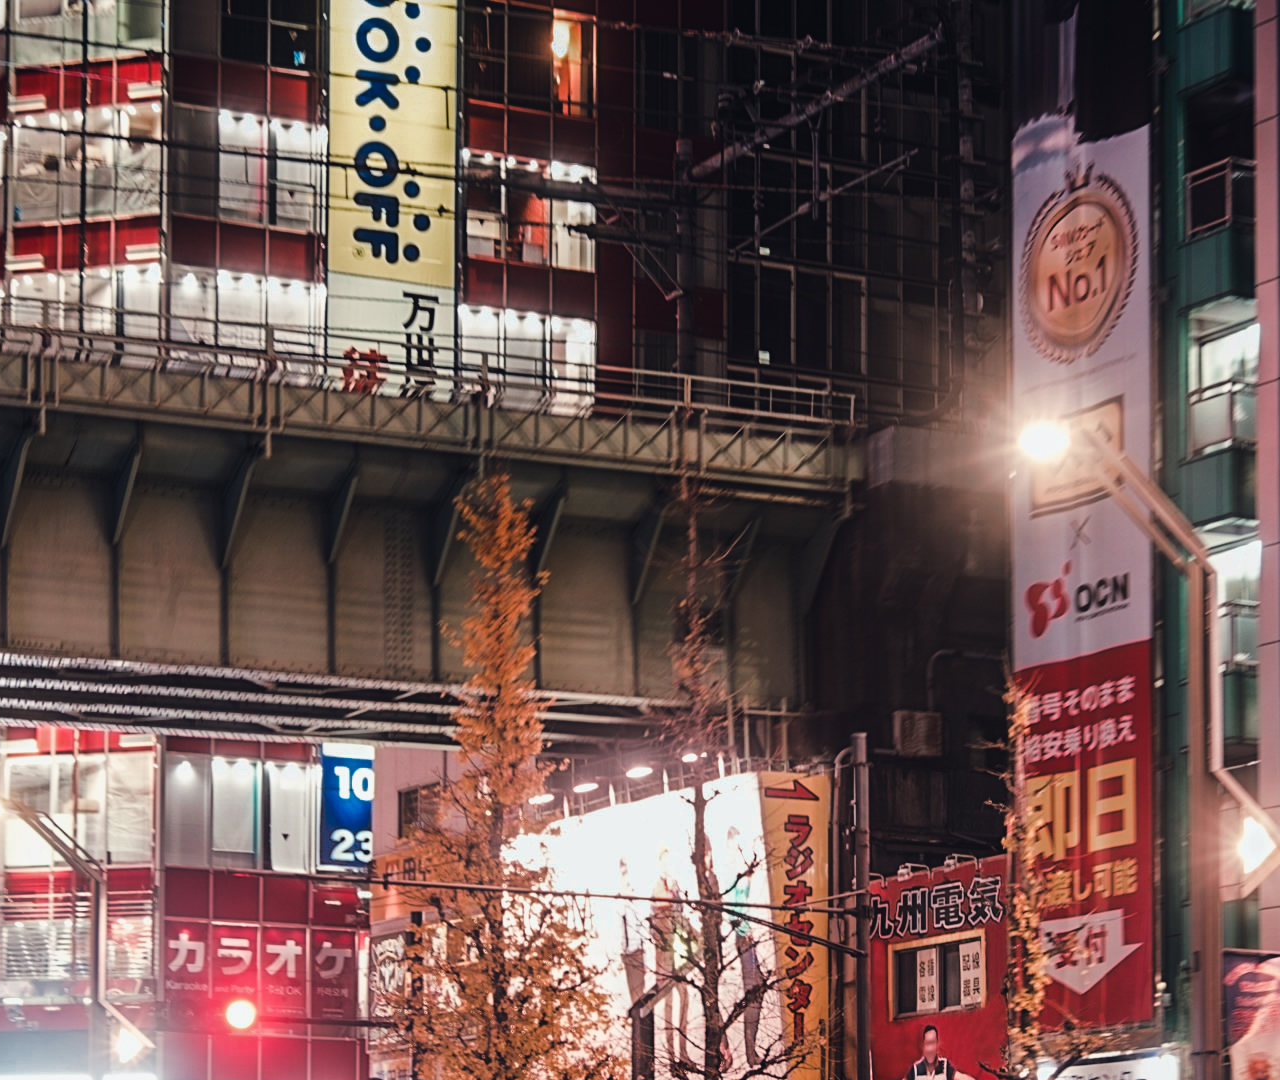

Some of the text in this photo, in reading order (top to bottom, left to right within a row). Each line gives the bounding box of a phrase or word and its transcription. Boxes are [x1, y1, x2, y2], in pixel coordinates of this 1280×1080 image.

[1048, 254, 1107, 312] No.1
[1075, 572, 1130, 613] OCN
[334, 766, 376, 801] 10
[1025, 757, 1137, 861] 即日
[330, 829, 373, 863] 23
[1042, 857, 1138, 907] 渡し可能
[784, 815, 815, 1046] ラジオセンター
[870, 876, 1005, 939] 九州電気
[168, 932, 353, 980] カラオケ
